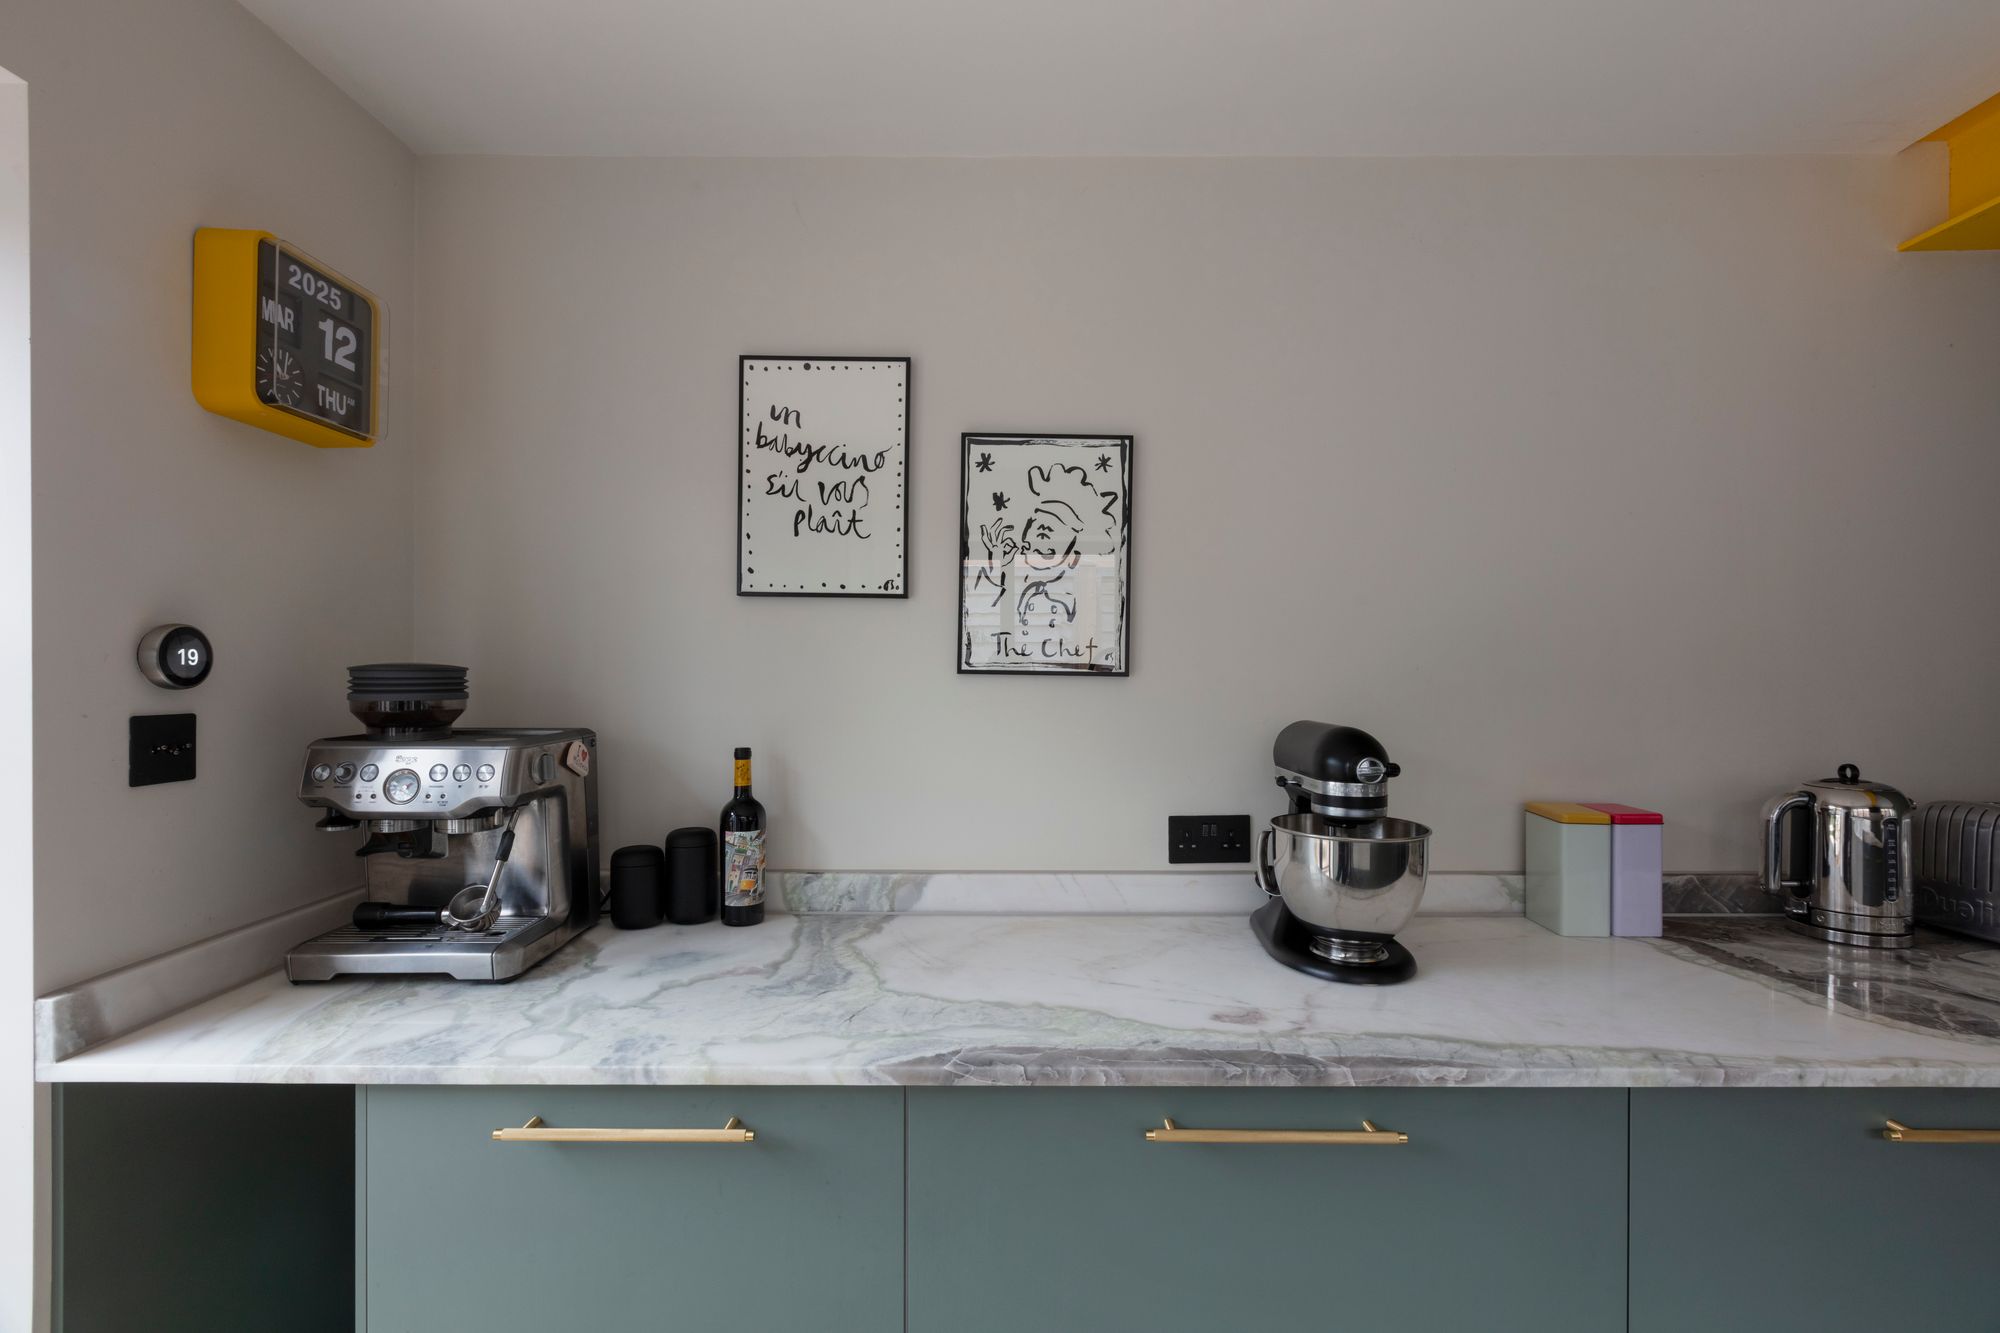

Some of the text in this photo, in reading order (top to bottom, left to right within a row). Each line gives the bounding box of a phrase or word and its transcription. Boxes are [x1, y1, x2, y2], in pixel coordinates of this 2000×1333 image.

[288, 264, 342, 311] 2025
[262, 296, 294, 333] MAR
[318, 318, 357, 372] 12
[317, 383, 347, 416] THU
[177, 648, 199, 666] 19
[990, 631, 1034, 658] The
[1041, 637, 1098, 666] Chef
